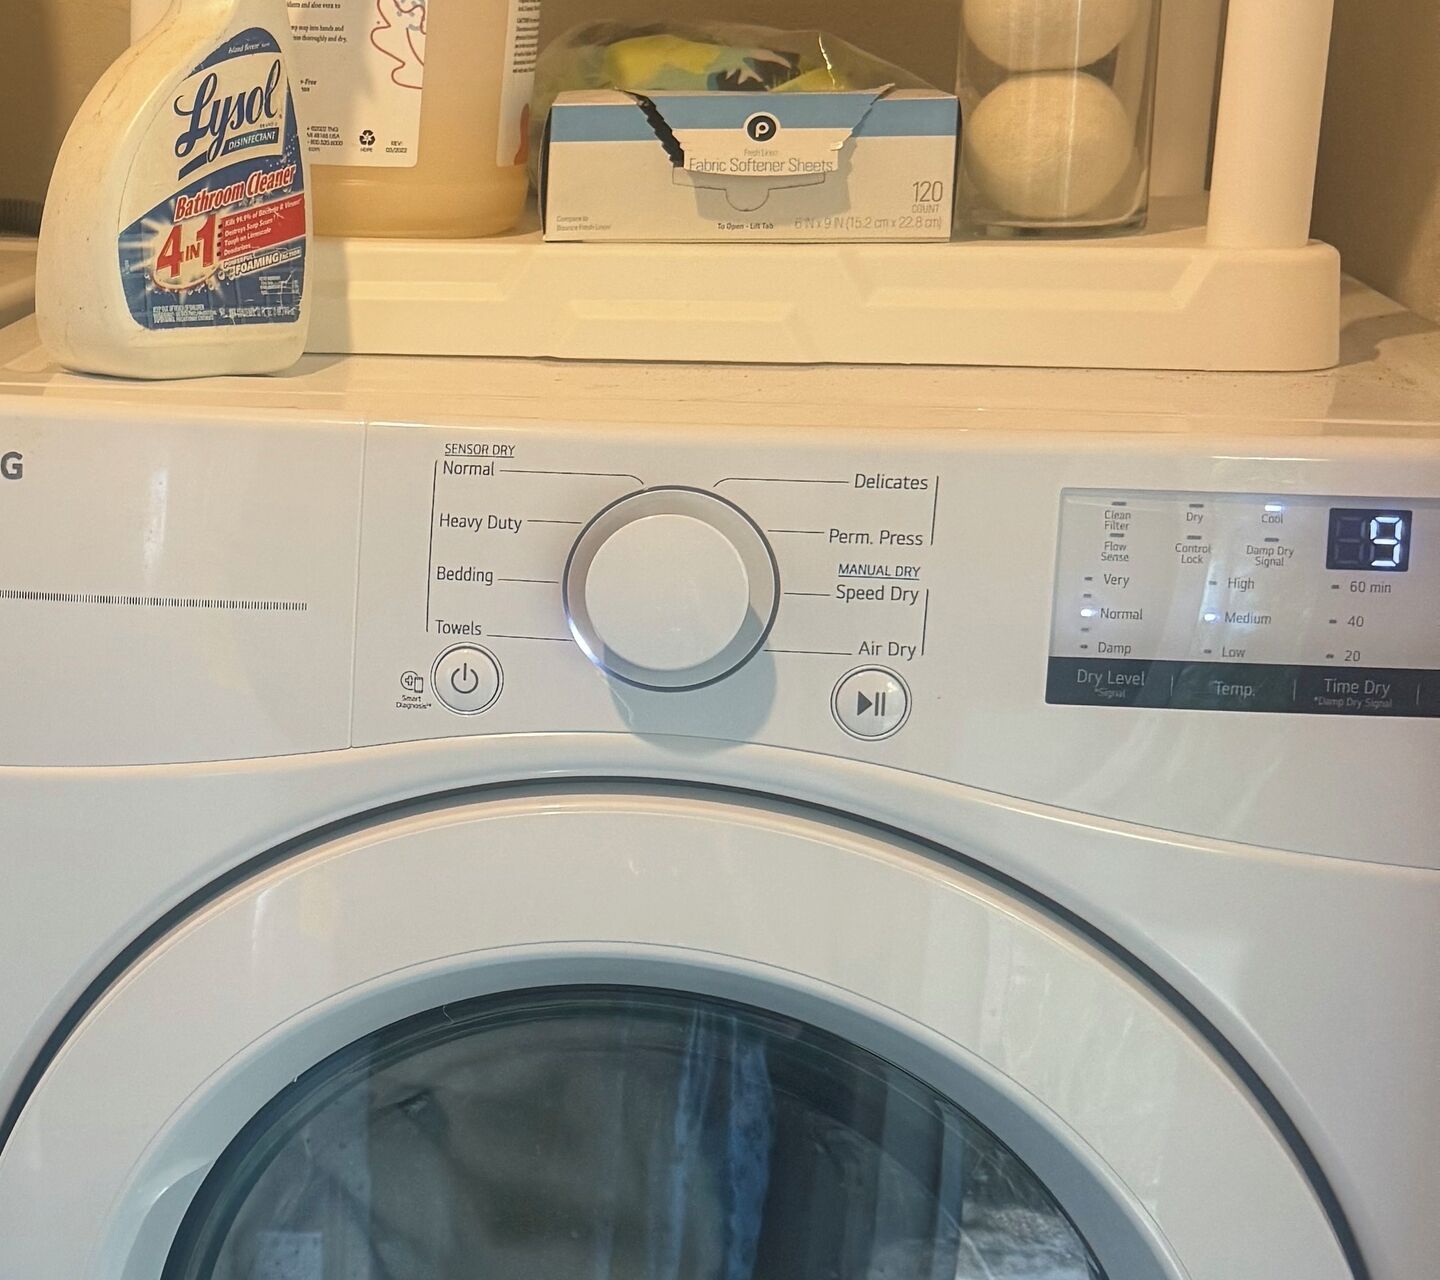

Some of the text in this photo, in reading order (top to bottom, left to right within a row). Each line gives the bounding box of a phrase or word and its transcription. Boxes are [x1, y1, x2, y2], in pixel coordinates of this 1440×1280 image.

[302, 35, 327, 43] thoroughly
[338, 35, 347, 43] dry.
[174, 59, 281, 163] Lysol
[229, 131, 275, 150] DISINFECTANT
[688, 158, 832, 172] Fabric Softener Sheets
[174, 164, 297, 222] Bathroom Cleaner
[912, 181, 943, 202] 120
[912, 204, 939, 213] COUNT
[718, 222, 725, 230] To
[727, 222, 744, 231] Open
[762, 222, 773, 230] Tab
[156, 214, 216, 279] 4 IN 1
[234, 249, 301, 276] FOAMING ACTION
[445, 444, 515, 456] SENSOR DRY
[443, 461, 494, 476] Normal
[855, 474, 928, 490] Delicates
[1104, 510, 1131, 520] Clean
[1186, 513, 1203, 524] Dry
[1262, 514, 1283, 524] Cool
[439, 514, 522, 533] Heavy Duty
[1104, 521, 1130, 531] Filter
[829, 529, 923, 545] Perm. Press
[1370, 517, 1402, 566] 9
[1104, 542, 1126, 551] Flow
[1175, 543, 1211, 553] Control
[1246, 545, 1294, 558] Damp Dry
[1101, 552, 1129, 561] Sense
[1181, 554, 1203, 564] Lock
[1255, 557, 1284, 568] Signal
[437, 567, 493, 586] Bedding
[838, 564, 921, 577] MANUAL DRY
[1104, 574, 1130, 588] Very
[1228, 577, 1255, 592] High
[1350, 581, 1391, 594] 60 min
[836, 584, 919, 606] Speed Dry
[1100, 608, 1143, 620] Normal
[1224, 612, 1271, 624] Medium
[435, 620, 481, 635] Towels
[1347, 616, 1364, 627] 40
[858, 641, 916, 661] Air Dry
[1098, 642, 1131, 656] Damp
[1222, 647, 1246, 659] Low
[1344, 650, 1360, 661] 20
[1077, 669, 1145, 688] Dry Level
[1214, 681, 1256, 699] Temp.
[1324, 679, 1390, 697] Time Dry
